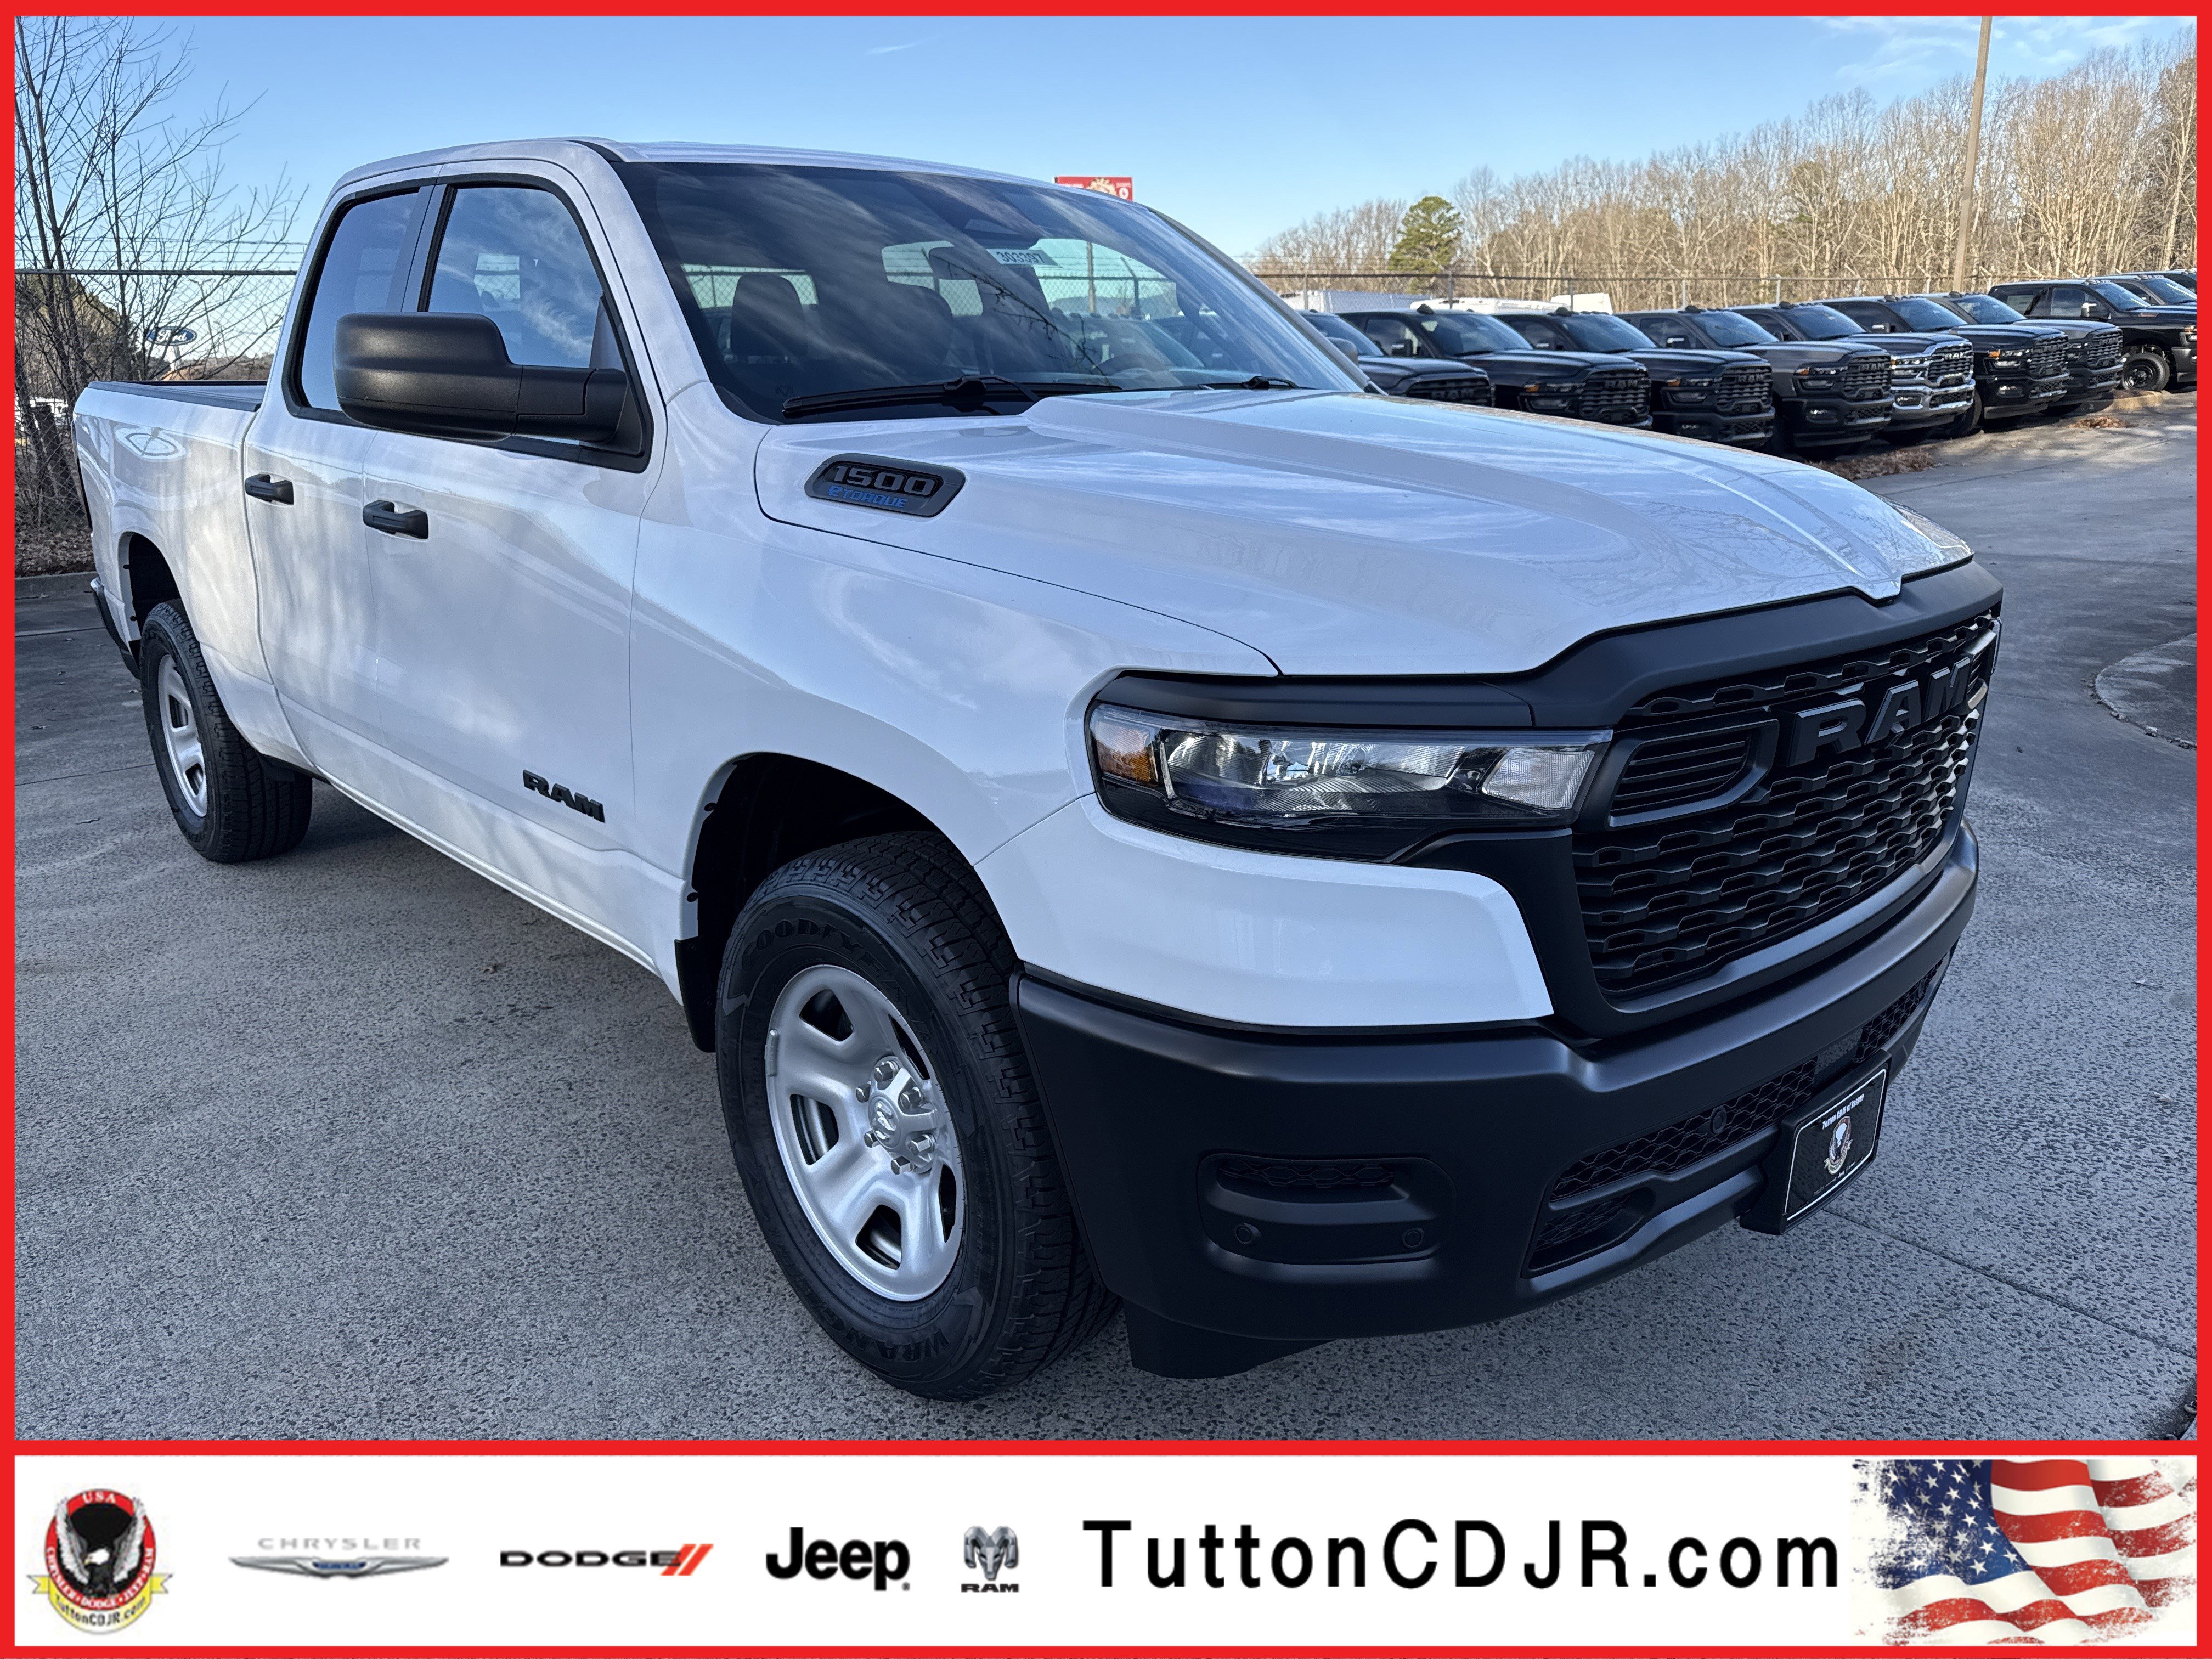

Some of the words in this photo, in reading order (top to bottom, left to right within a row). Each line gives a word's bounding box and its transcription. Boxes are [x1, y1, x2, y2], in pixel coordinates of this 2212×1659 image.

[996, 251, 1045, 263] 303397
[833, 466, 936, 495] 1500
[1787, 656, 1971, 767] RAM
[523, 769, 606, 823] RAM
